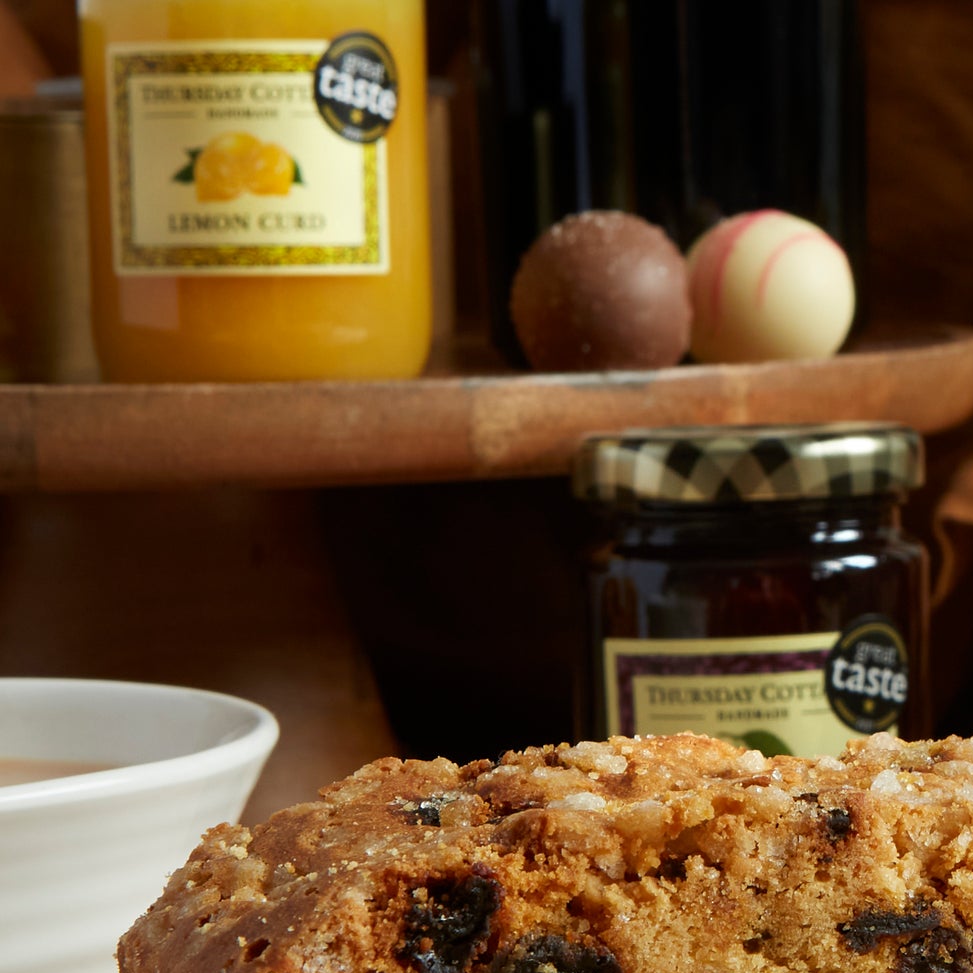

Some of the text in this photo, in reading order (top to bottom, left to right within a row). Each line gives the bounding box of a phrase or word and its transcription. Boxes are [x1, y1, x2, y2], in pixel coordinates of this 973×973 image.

[250, 83, 309, 102] COTT
[318, 65, 397, 121] taste
[168, 212, 327, 234] LEMON CURD
[854, 641, 897, 668] great
[831, 657, 909, 704] taste
[648, 684, 757, 706] THURSDAY
